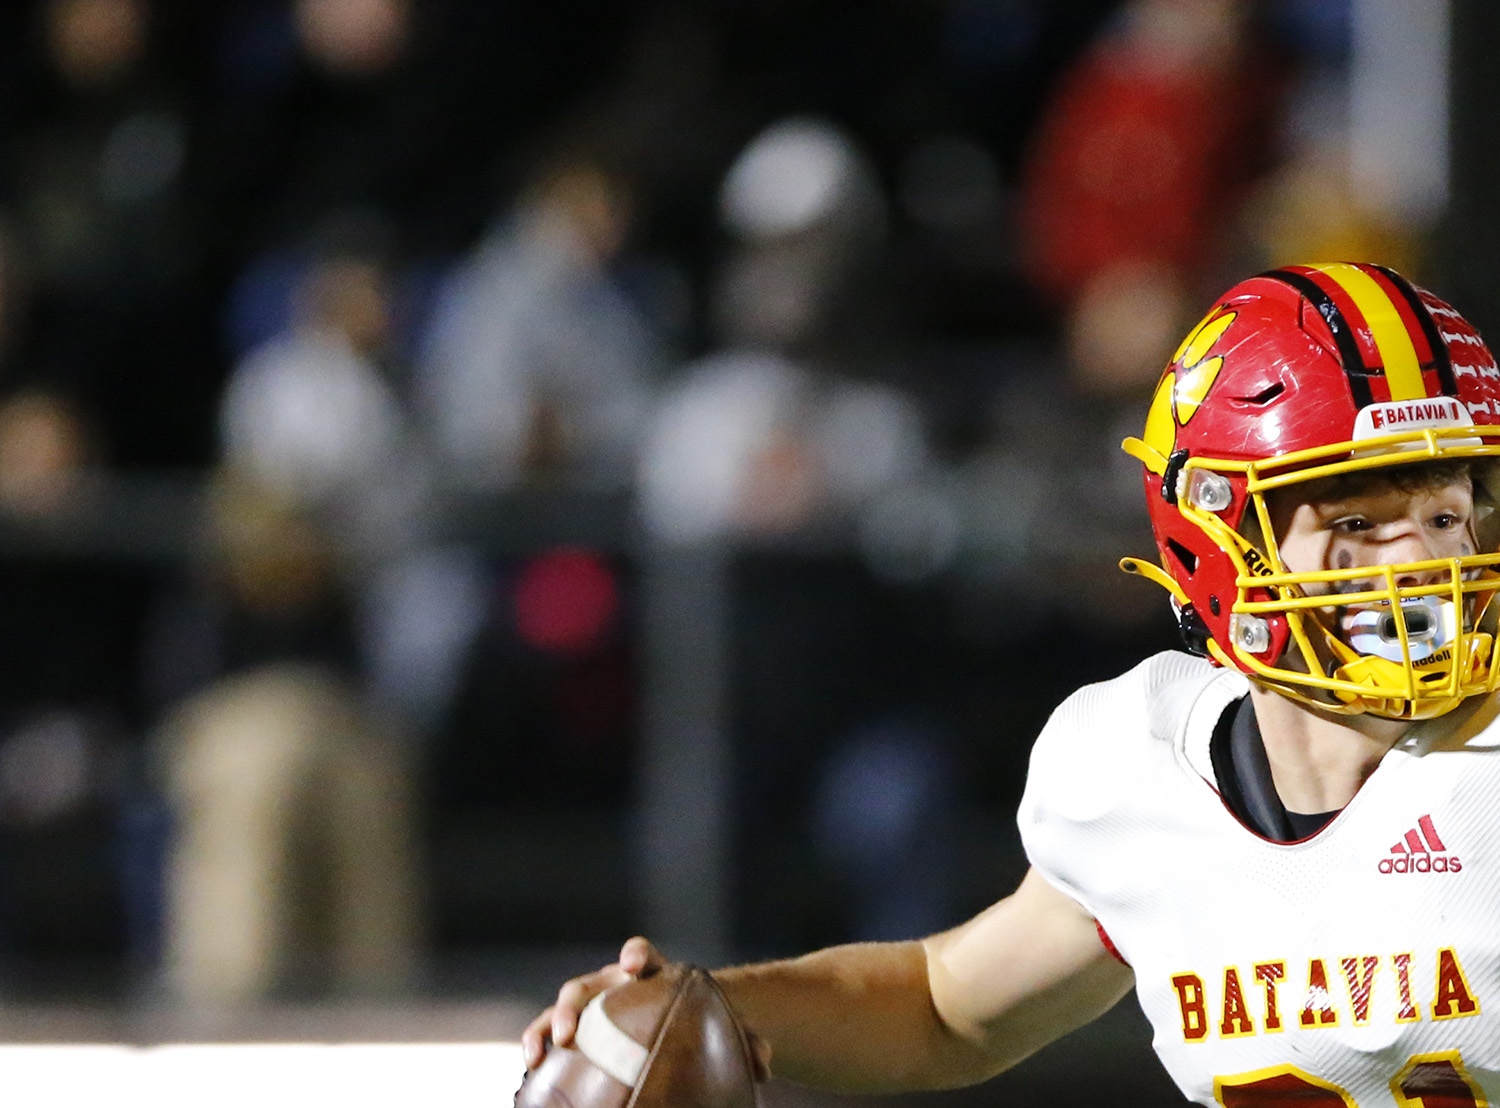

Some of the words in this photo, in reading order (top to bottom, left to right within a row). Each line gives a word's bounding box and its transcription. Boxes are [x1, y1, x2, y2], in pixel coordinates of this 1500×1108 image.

[1386, 404, 1448, 424] BATAVIA
[1378, 852, 1462, 874] adidas
[1171, 946, 1480, 1043] BATAVIA
